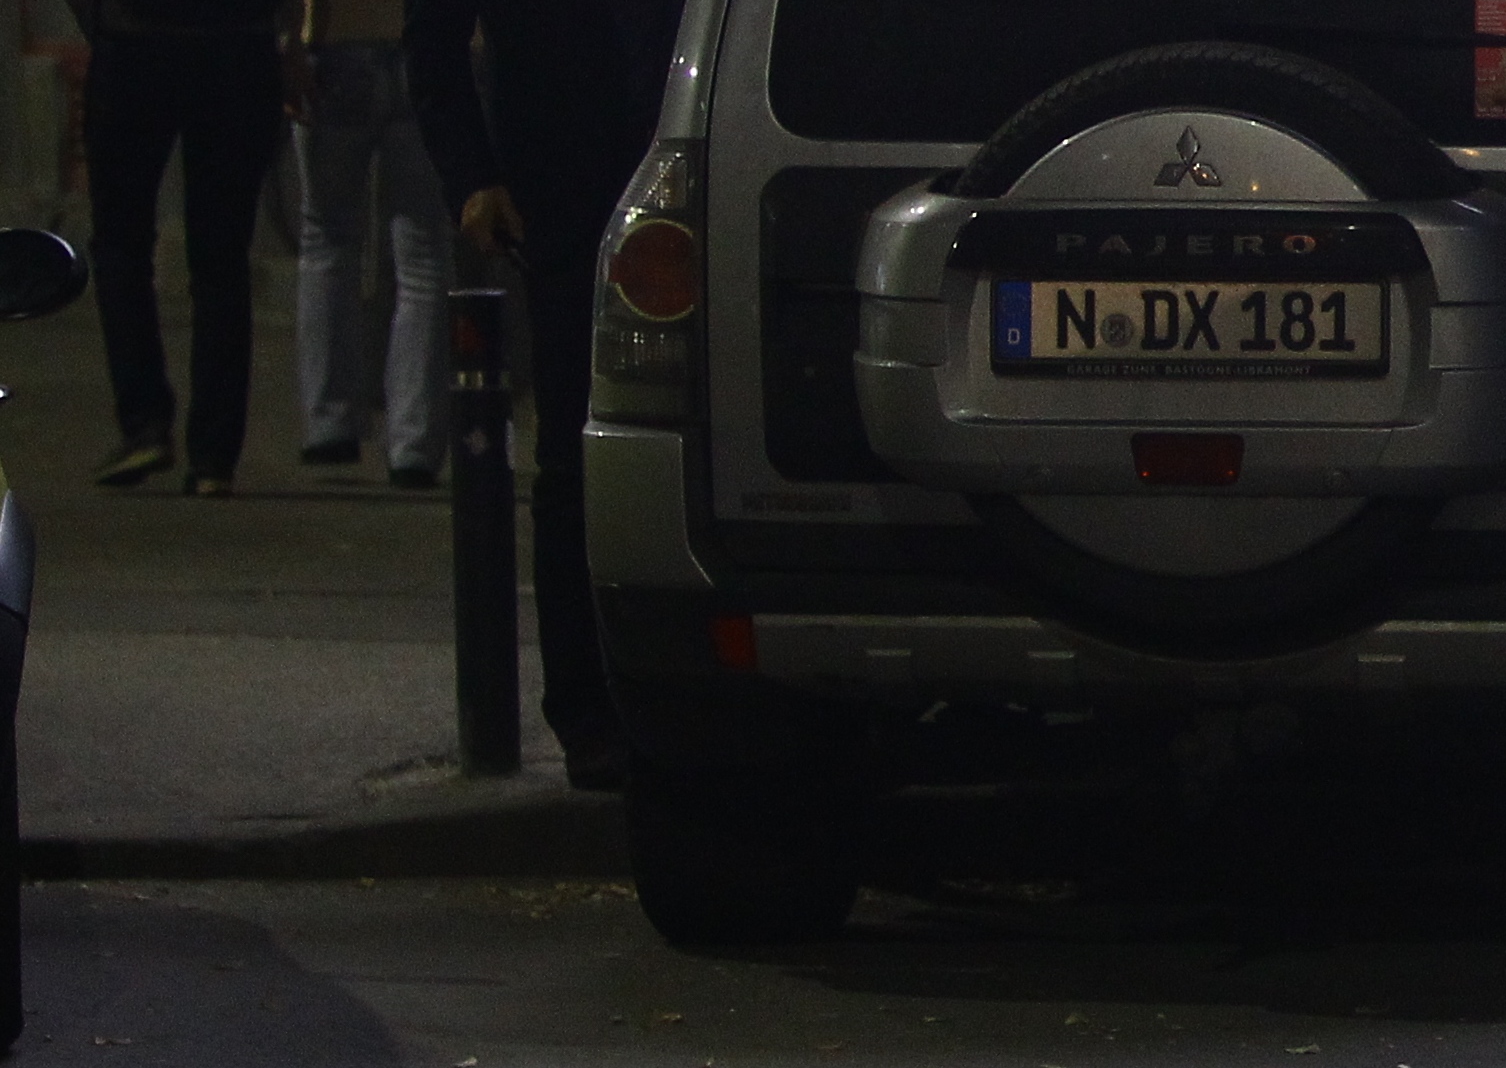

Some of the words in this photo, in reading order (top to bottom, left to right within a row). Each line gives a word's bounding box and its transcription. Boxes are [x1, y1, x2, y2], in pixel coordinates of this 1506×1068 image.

[1055, 233, 1317, 255] PAJERO
[1056, 288, 1097, 350] N
[1141, 289, 1221, 352] DX
[1240, 289, 1356, 352] 181
[1007, 327, 1021, 346] D
